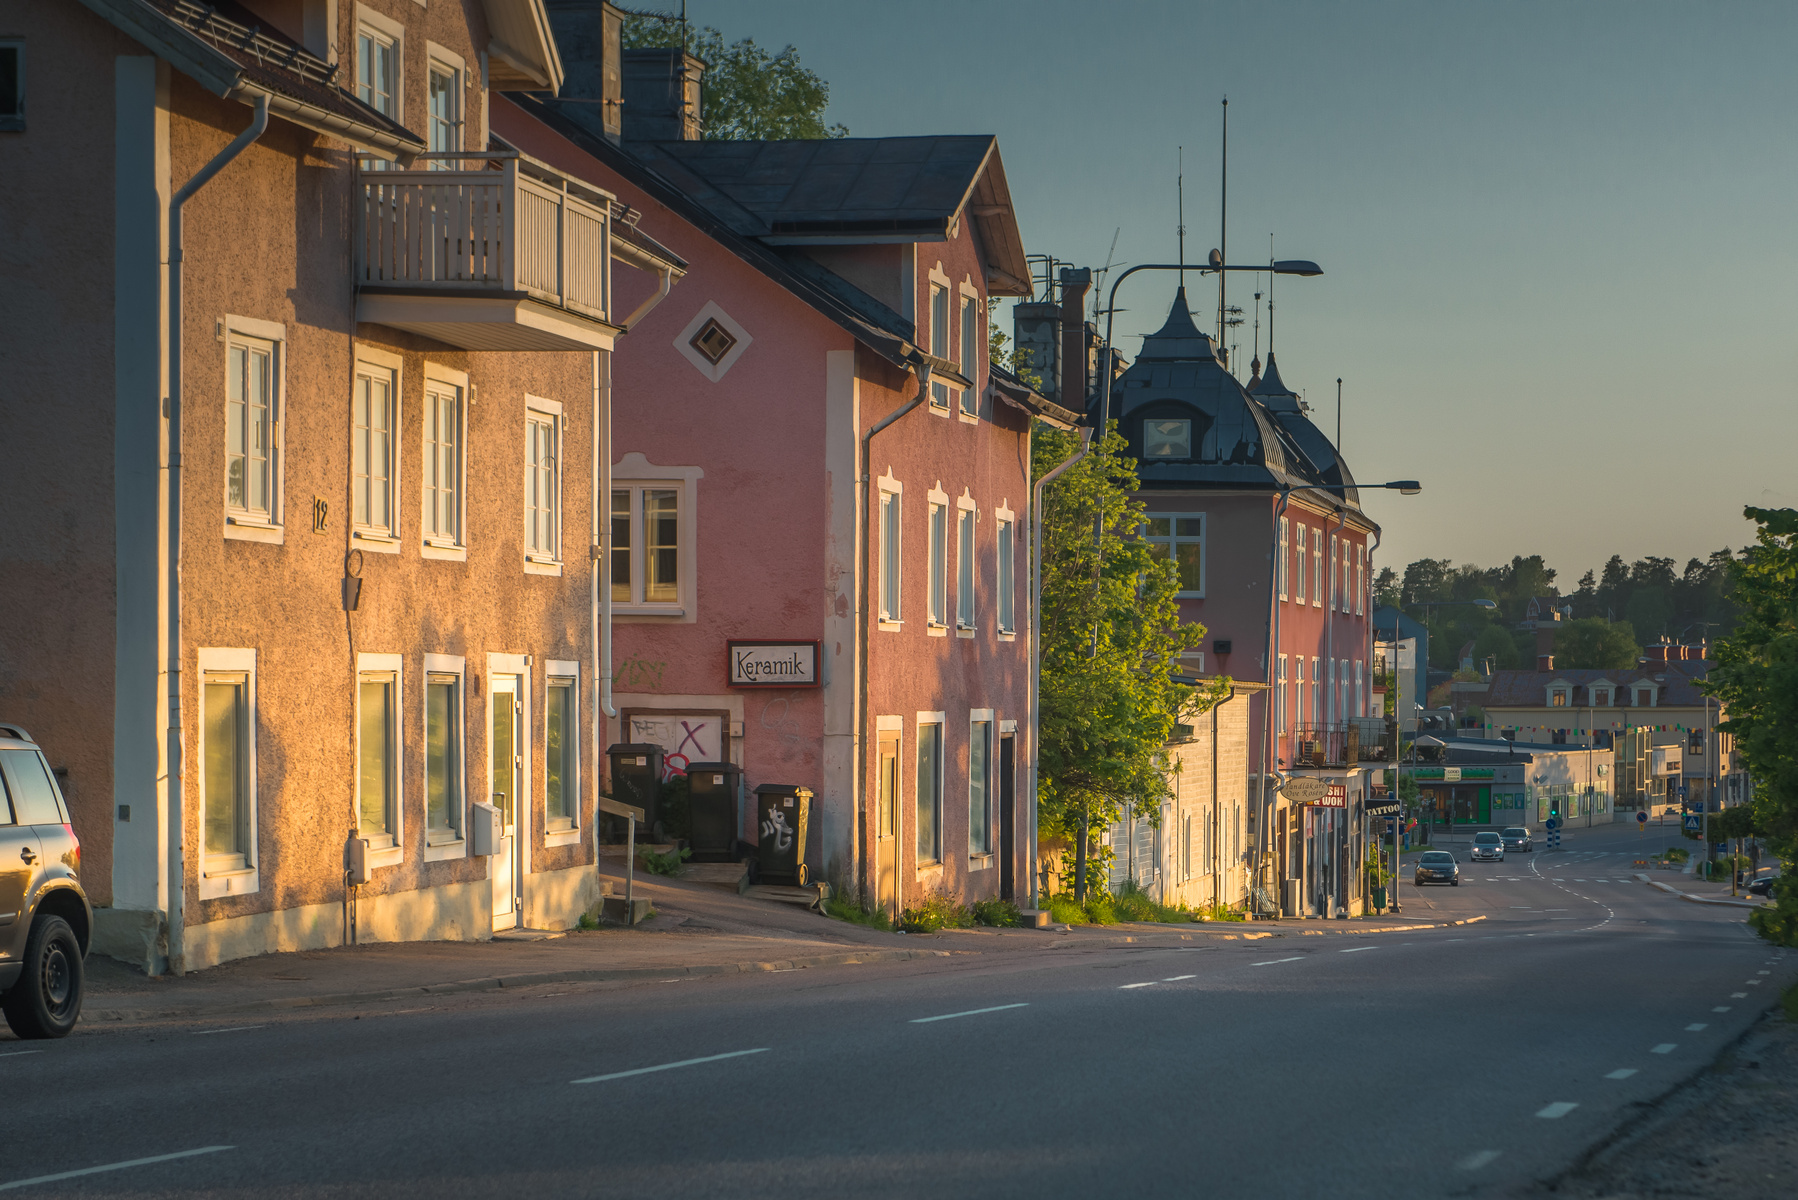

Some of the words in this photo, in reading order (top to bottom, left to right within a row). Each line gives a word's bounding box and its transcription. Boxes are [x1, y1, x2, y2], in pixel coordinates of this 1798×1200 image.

[316, 499, 328, 531] 12
[736, 651, 806, 682] Keramik
[1286, 782, 1325, 791] Tandläkare
[1327, 786, 1344, 796] SHI
[1322, 796, 1344, 806] WOK
[1366, 804, 1400, 817] TATTOO
